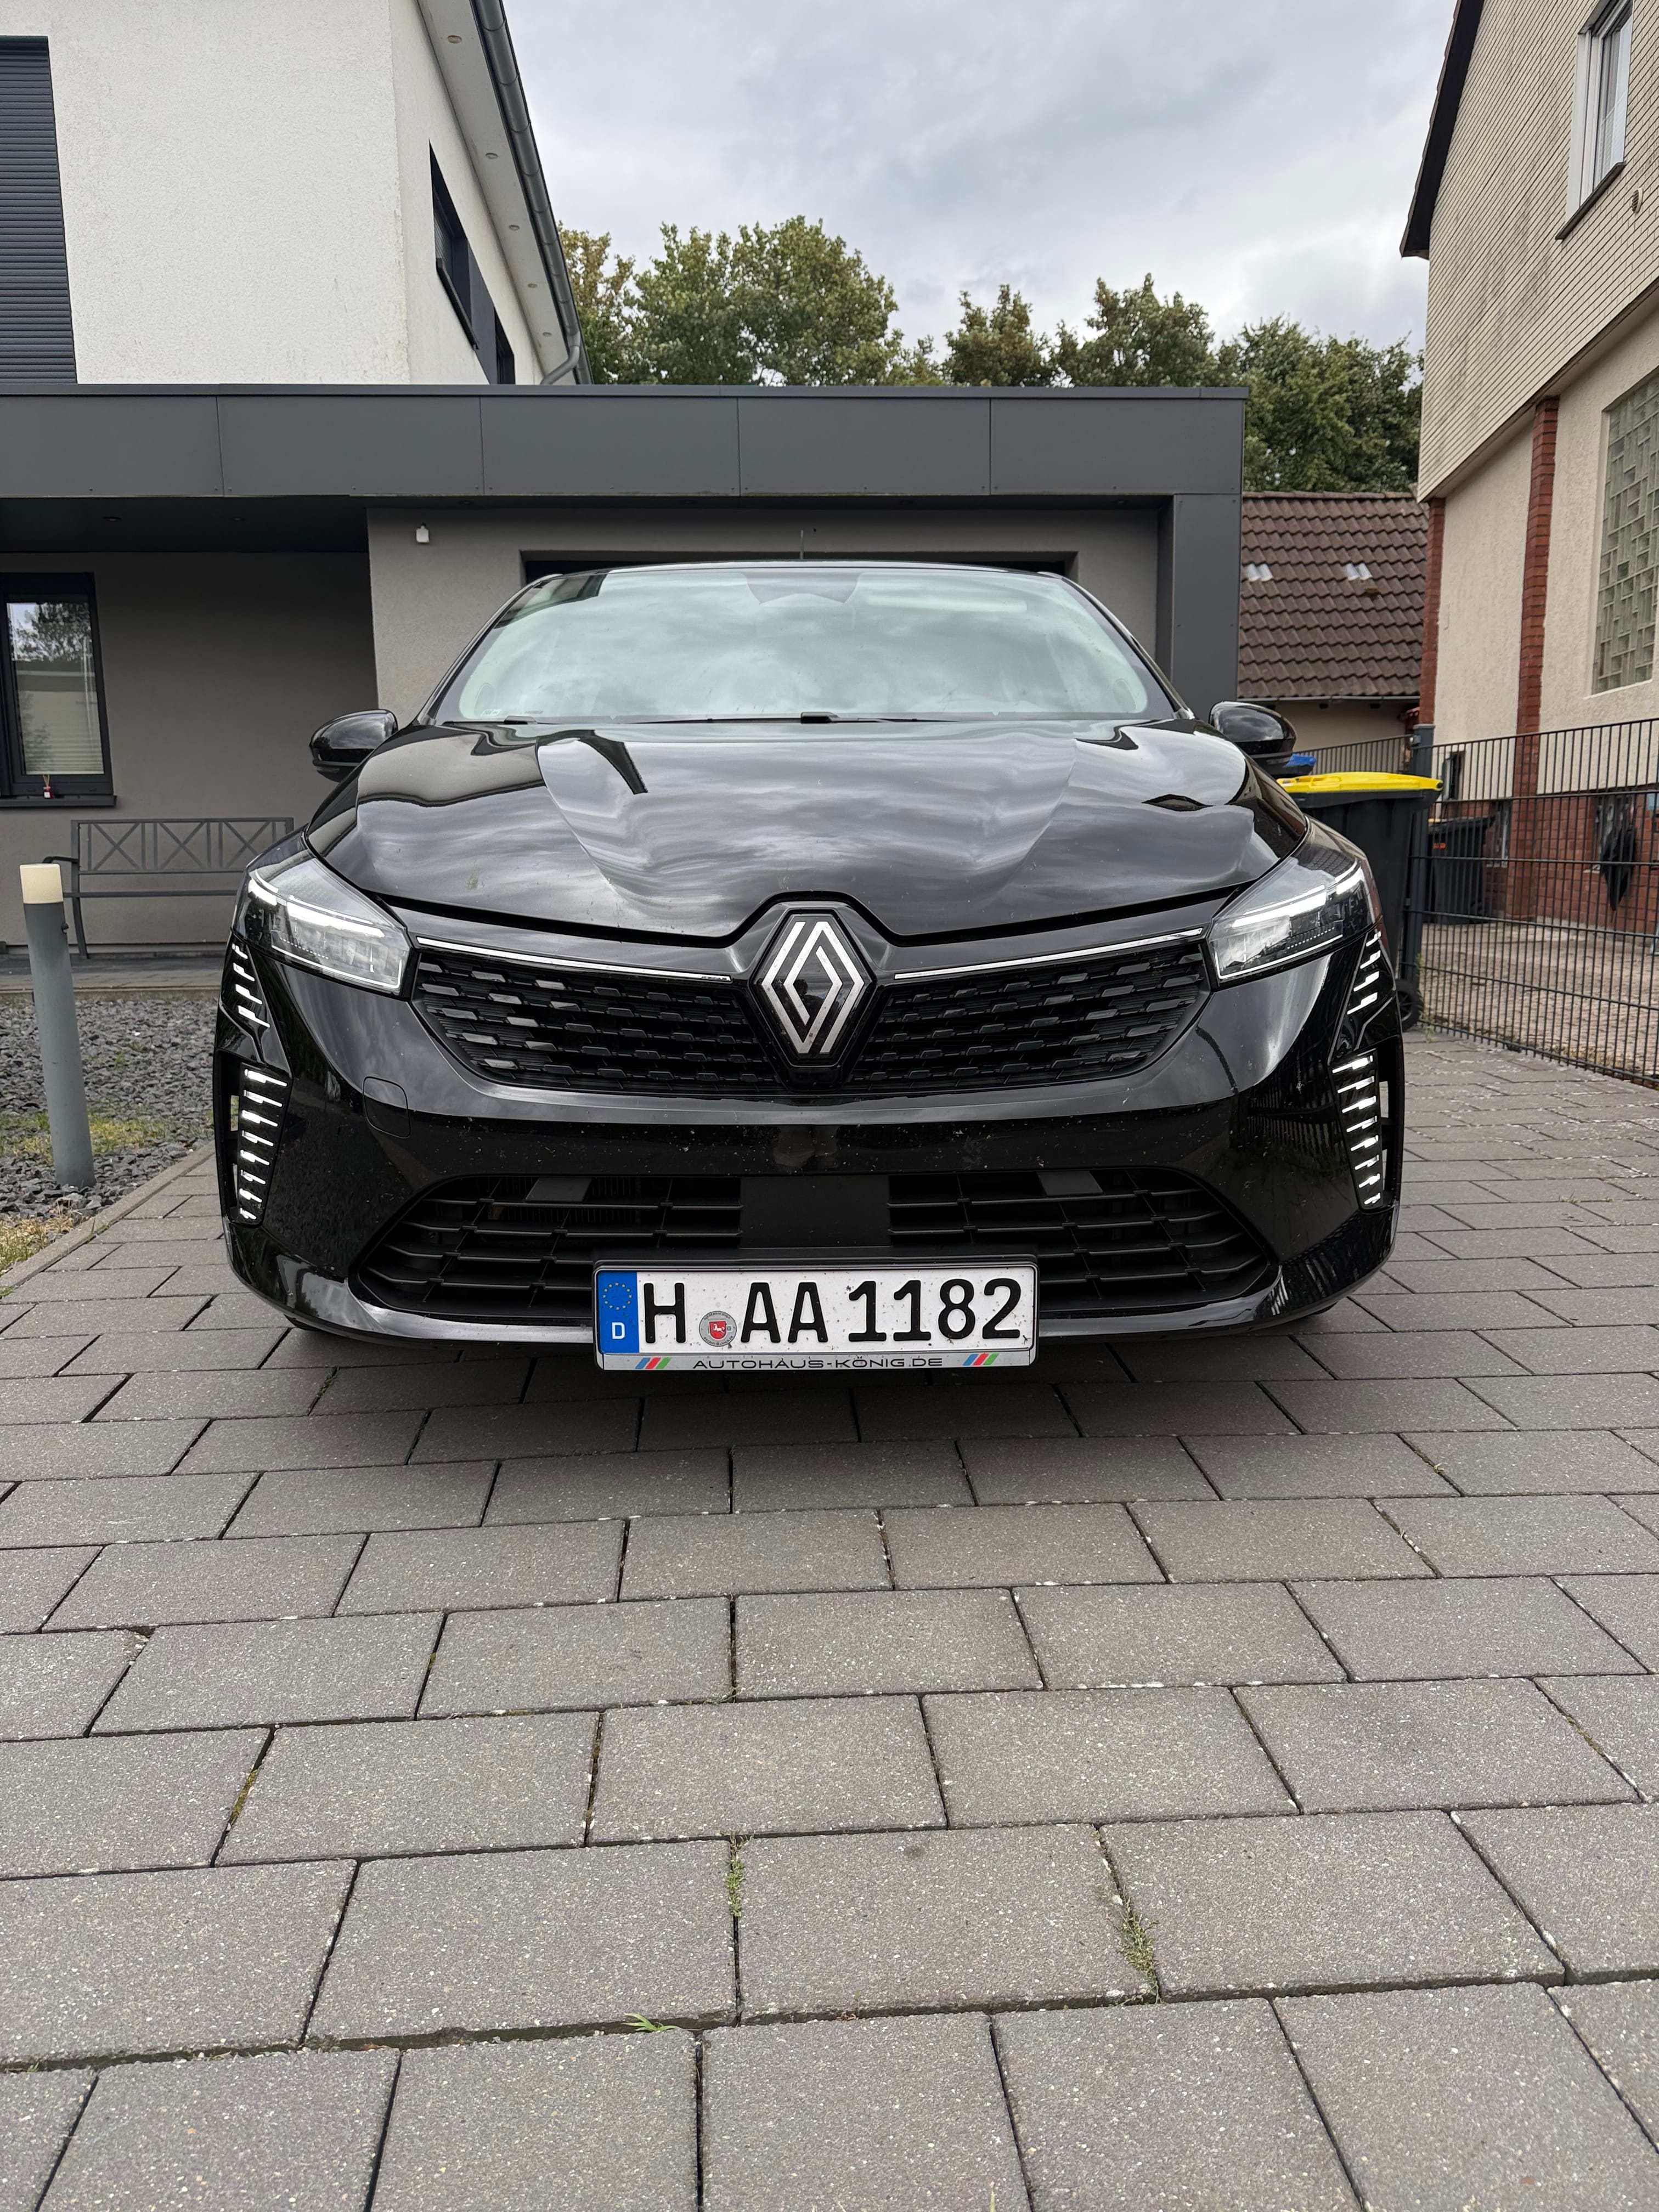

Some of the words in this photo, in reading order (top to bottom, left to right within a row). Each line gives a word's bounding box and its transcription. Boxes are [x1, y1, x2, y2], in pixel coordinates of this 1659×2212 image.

[644, 1283, 686, 1344] H
[740, 1282, 828, 1344] AA
[848, 1278, 1022, 1342] 1182
[612, 1322, 625, 1339] D
[692, 1357, 943, 1369] AUTOHAUS-KÖNIG.DE
